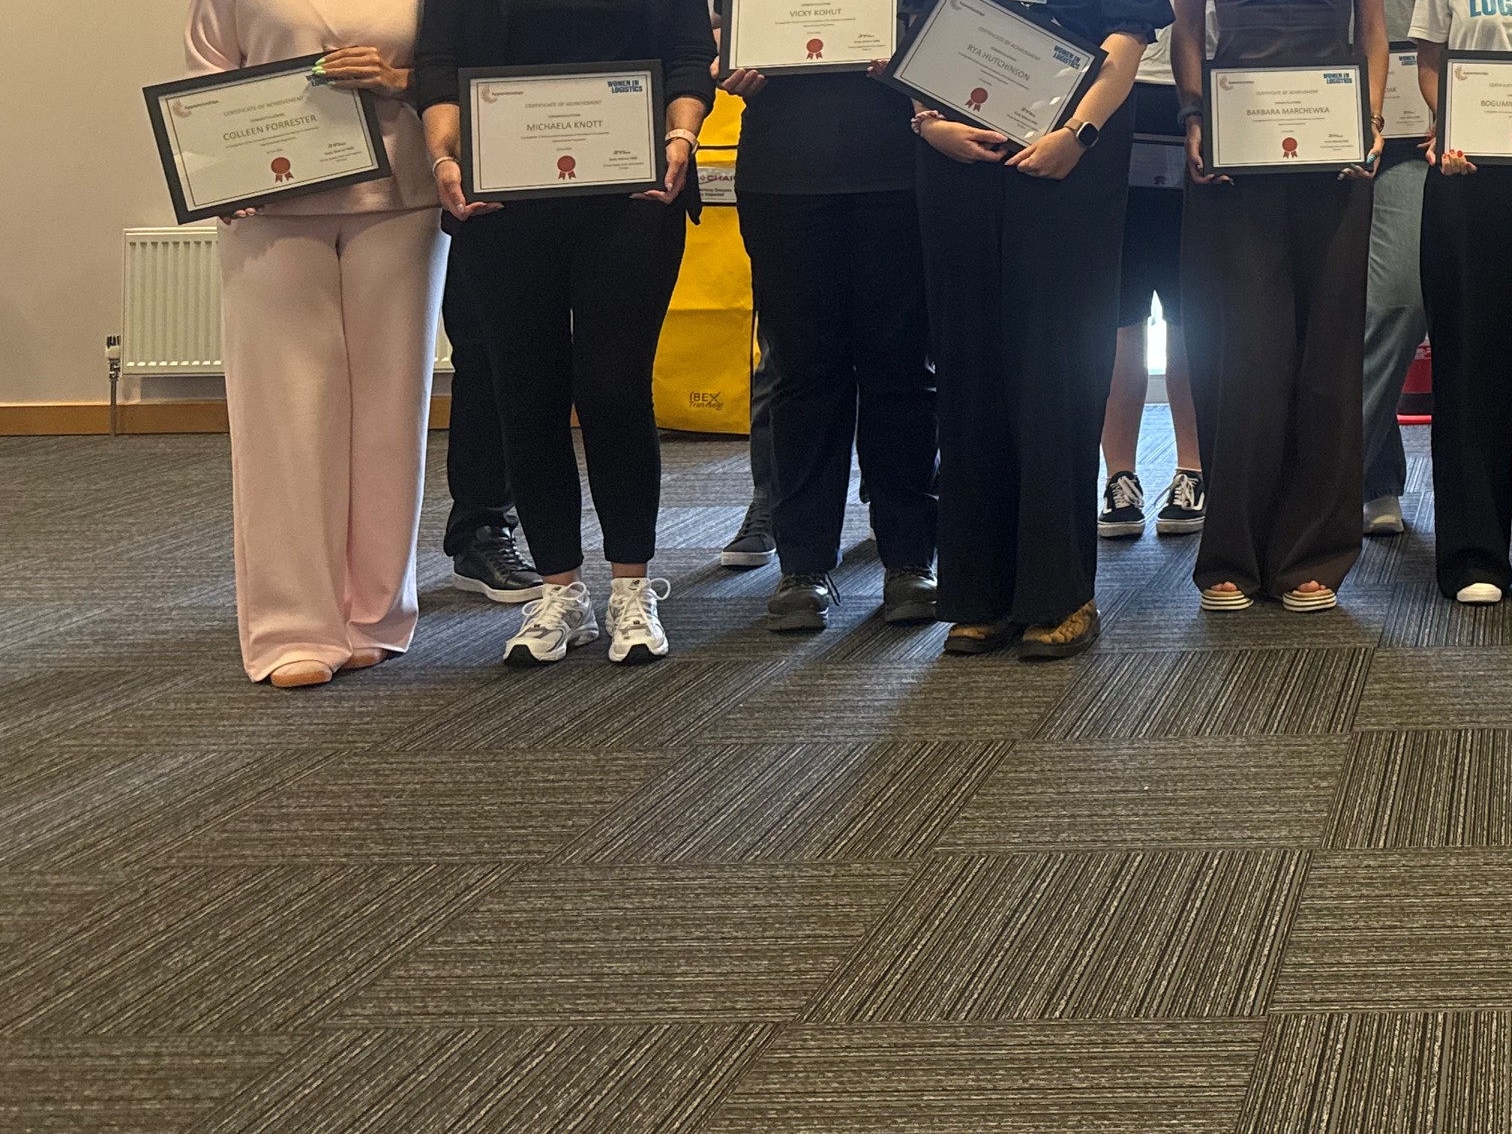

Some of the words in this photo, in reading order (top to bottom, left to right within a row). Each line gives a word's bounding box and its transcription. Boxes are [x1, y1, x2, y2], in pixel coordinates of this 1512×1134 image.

[789, 9, 812, 17] VICKY
[814, 8, 842, 16] KOHUT
[967, 44, 982, 56] RYA
[982, 52, 1030, 81] HUTCHINSON
[1281, 107, 1330, 115] MARCHEWKA
[223, 126, 264, 141] COLLEEN
[265, 114, 317, 131] FORRESTER
[526, 122, 572, 131] MICHAELA
[574, 120, 603, 129] KNOTT
